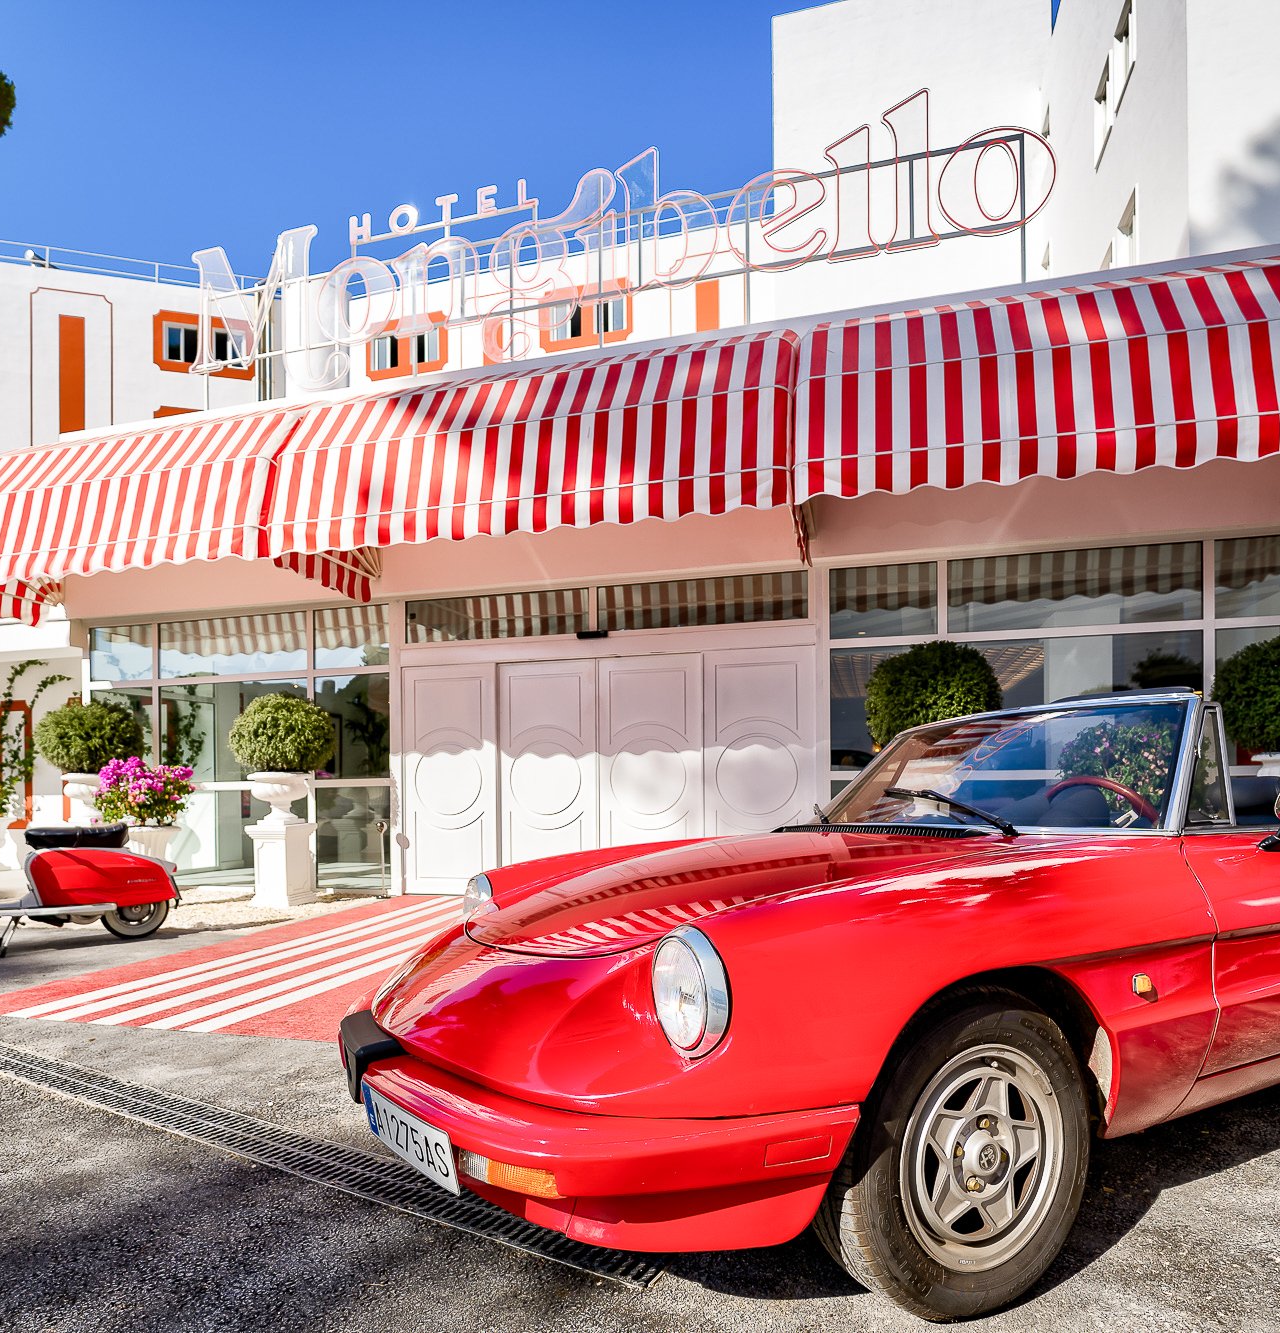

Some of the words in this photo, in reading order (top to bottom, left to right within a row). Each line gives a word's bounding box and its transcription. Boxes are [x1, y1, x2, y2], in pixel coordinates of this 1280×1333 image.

[189, 87, 1058, 392] Mongibello
[348, 178, 539, 245] HOTEL
[374, 1101, 450, 1178] A1275AS
